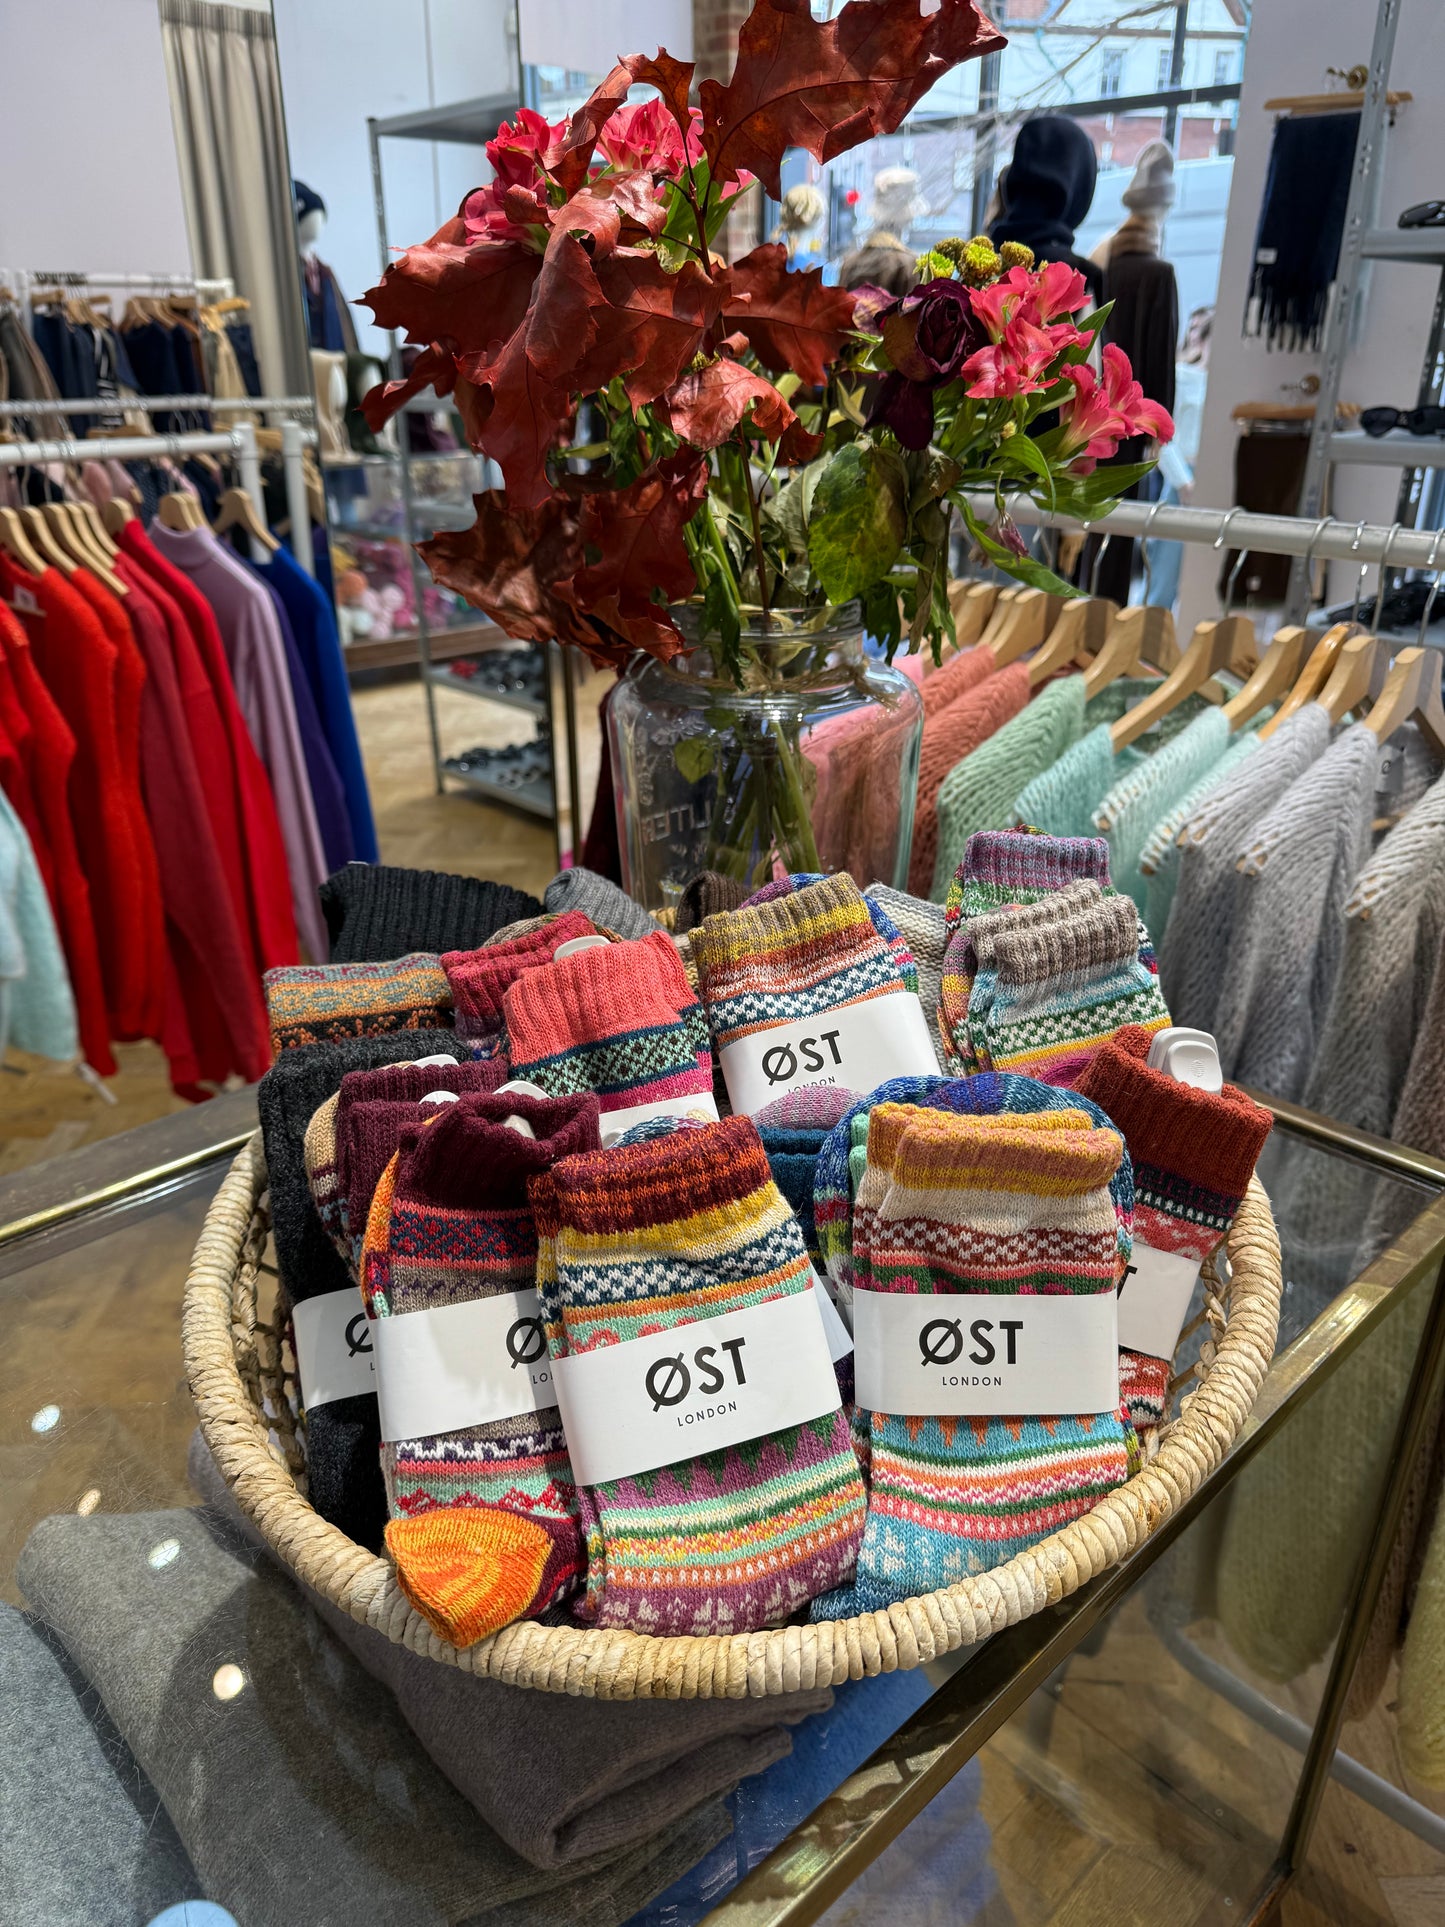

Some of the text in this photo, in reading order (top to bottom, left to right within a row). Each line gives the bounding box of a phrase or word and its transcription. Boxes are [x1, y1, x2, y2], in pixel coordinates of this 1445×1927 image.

[761, 1029, 842, 1087] ØST
[918, 1317, 1024, 1367] ØST
[645, 1336, 748, 1413] ØST
[941, 1376, 1004, 1387] LONDON
[677, 1400, 739, 1427] LONDON
